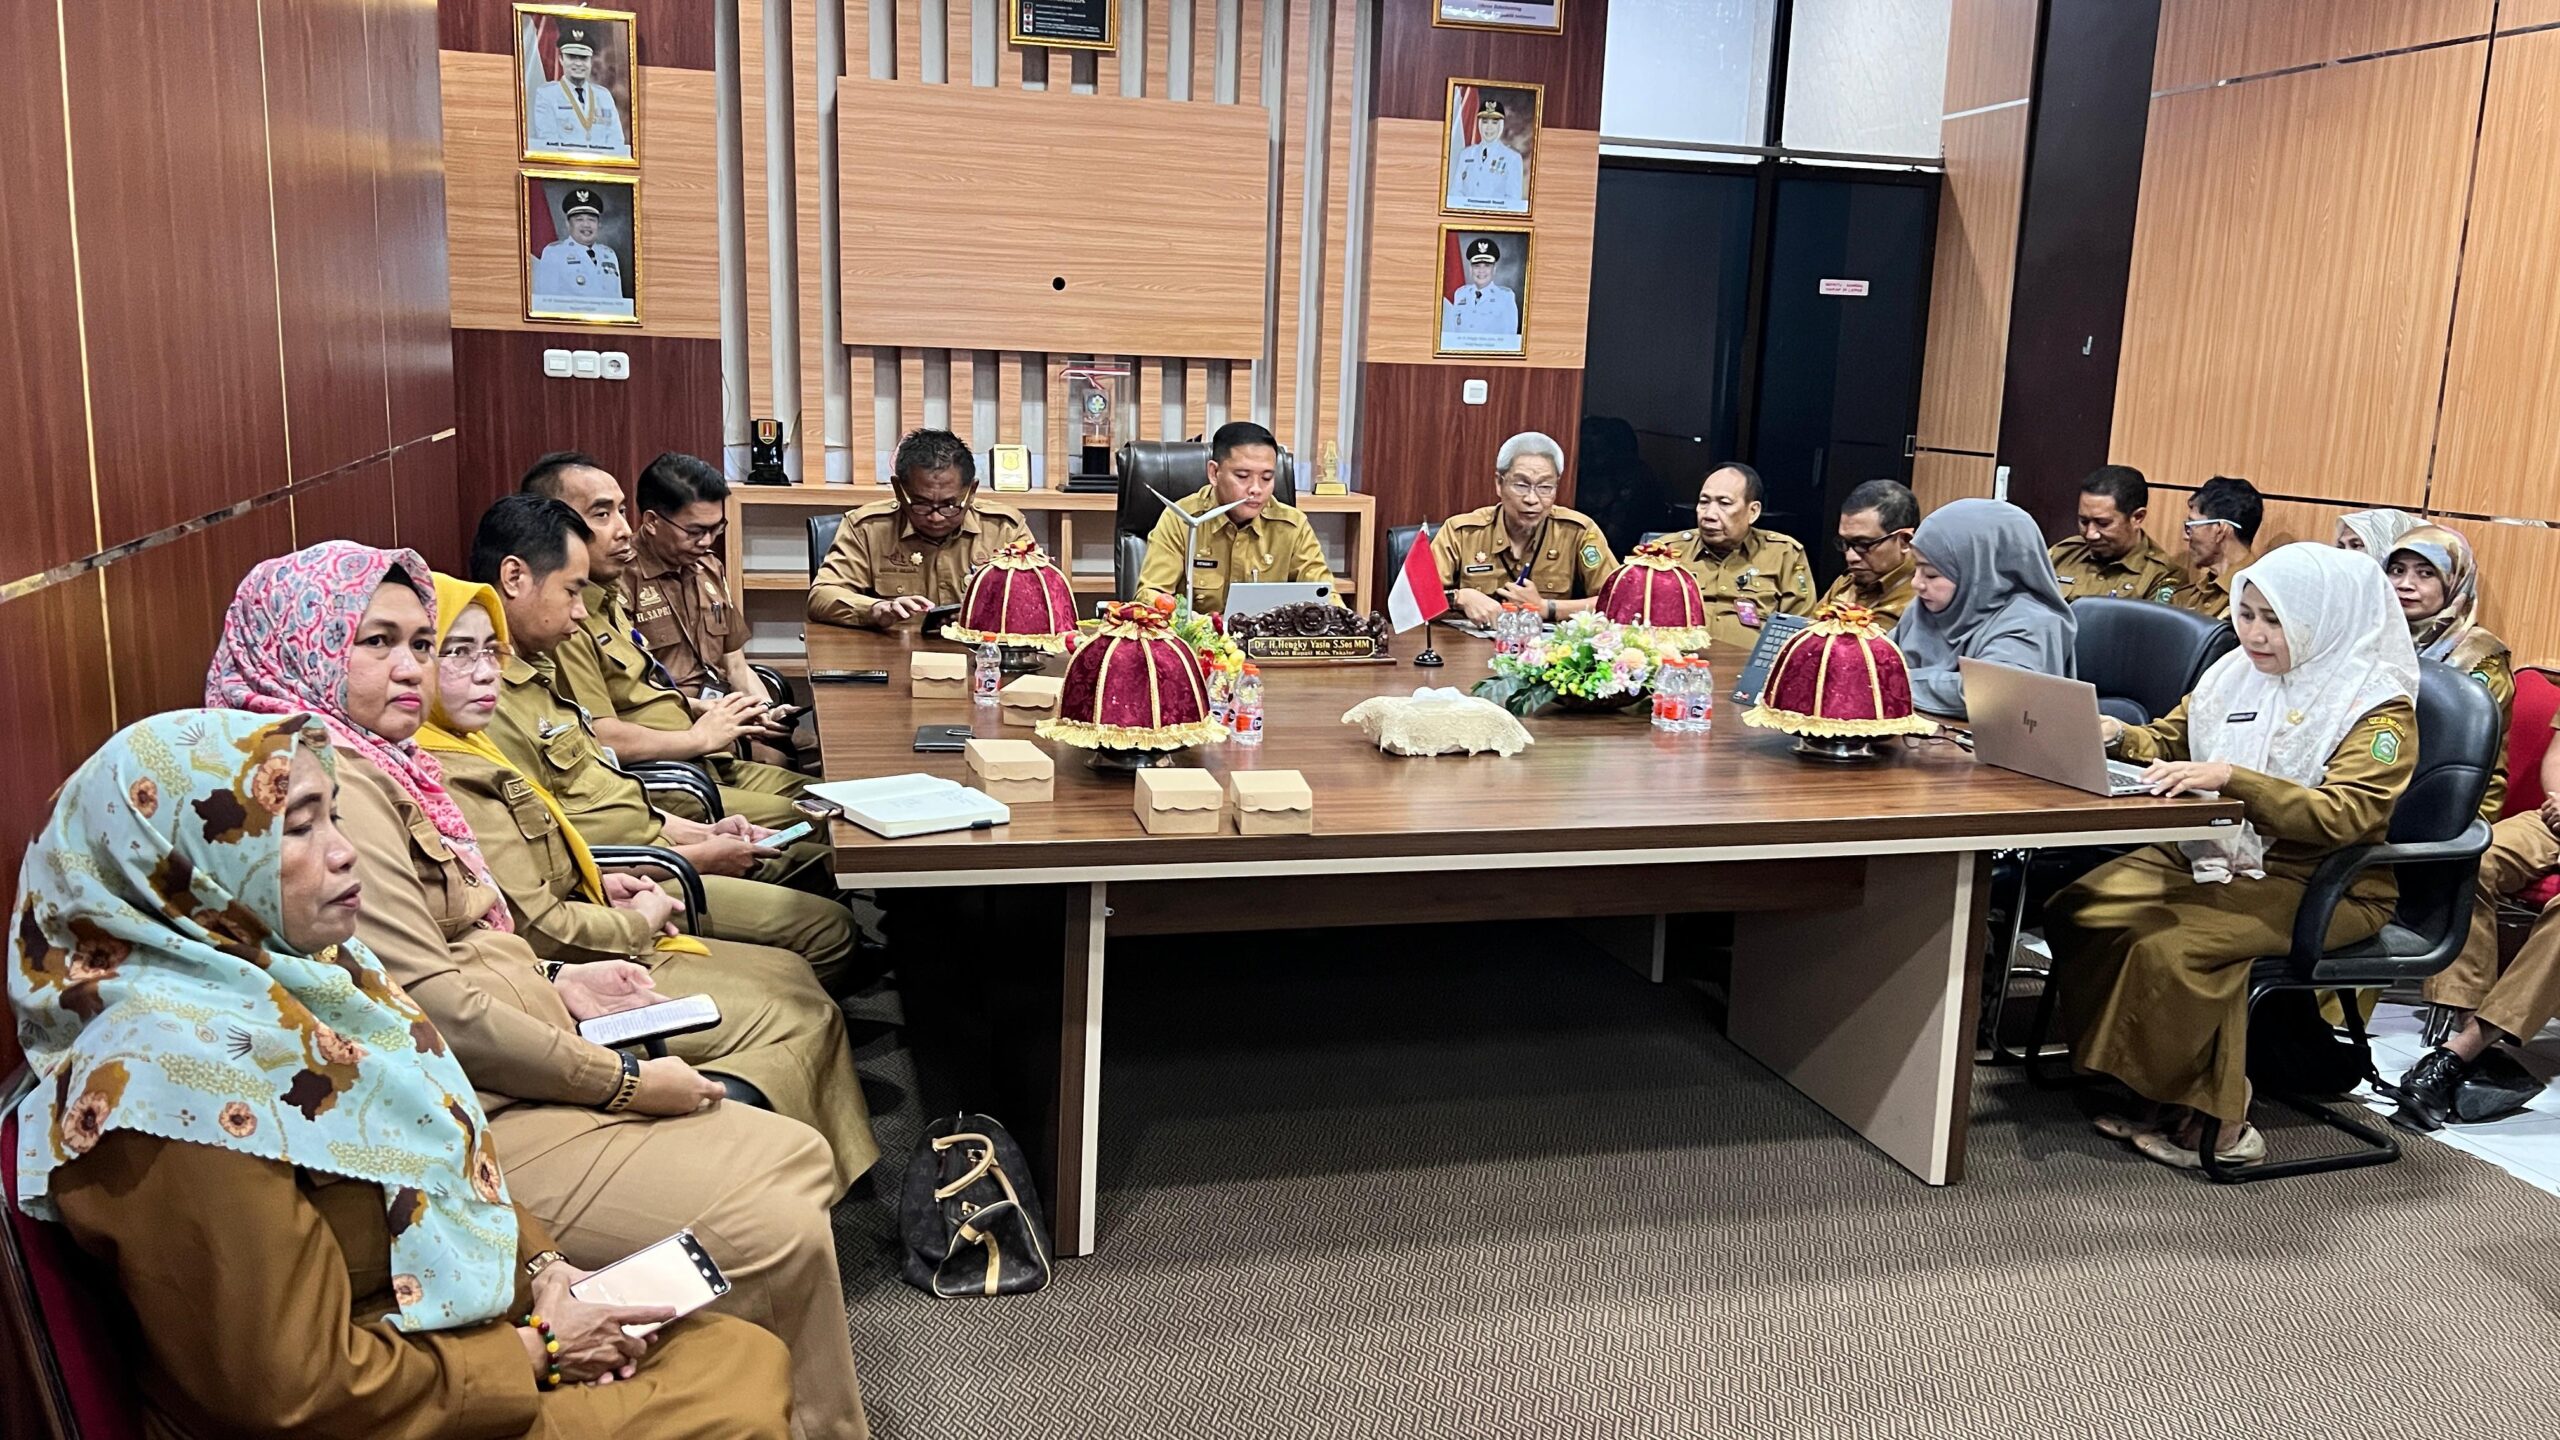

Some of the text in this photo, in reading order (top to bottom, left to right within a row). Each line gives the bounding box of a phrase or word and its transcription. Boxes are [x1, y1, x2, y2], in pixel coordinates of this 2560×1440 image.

[1254, 640, 1265, 649] Dr.
[1310, 640, 1331, 649] Yasin
[1354, 639, 1370, 649] MM
[2023, 710, 2038, 734] hp
